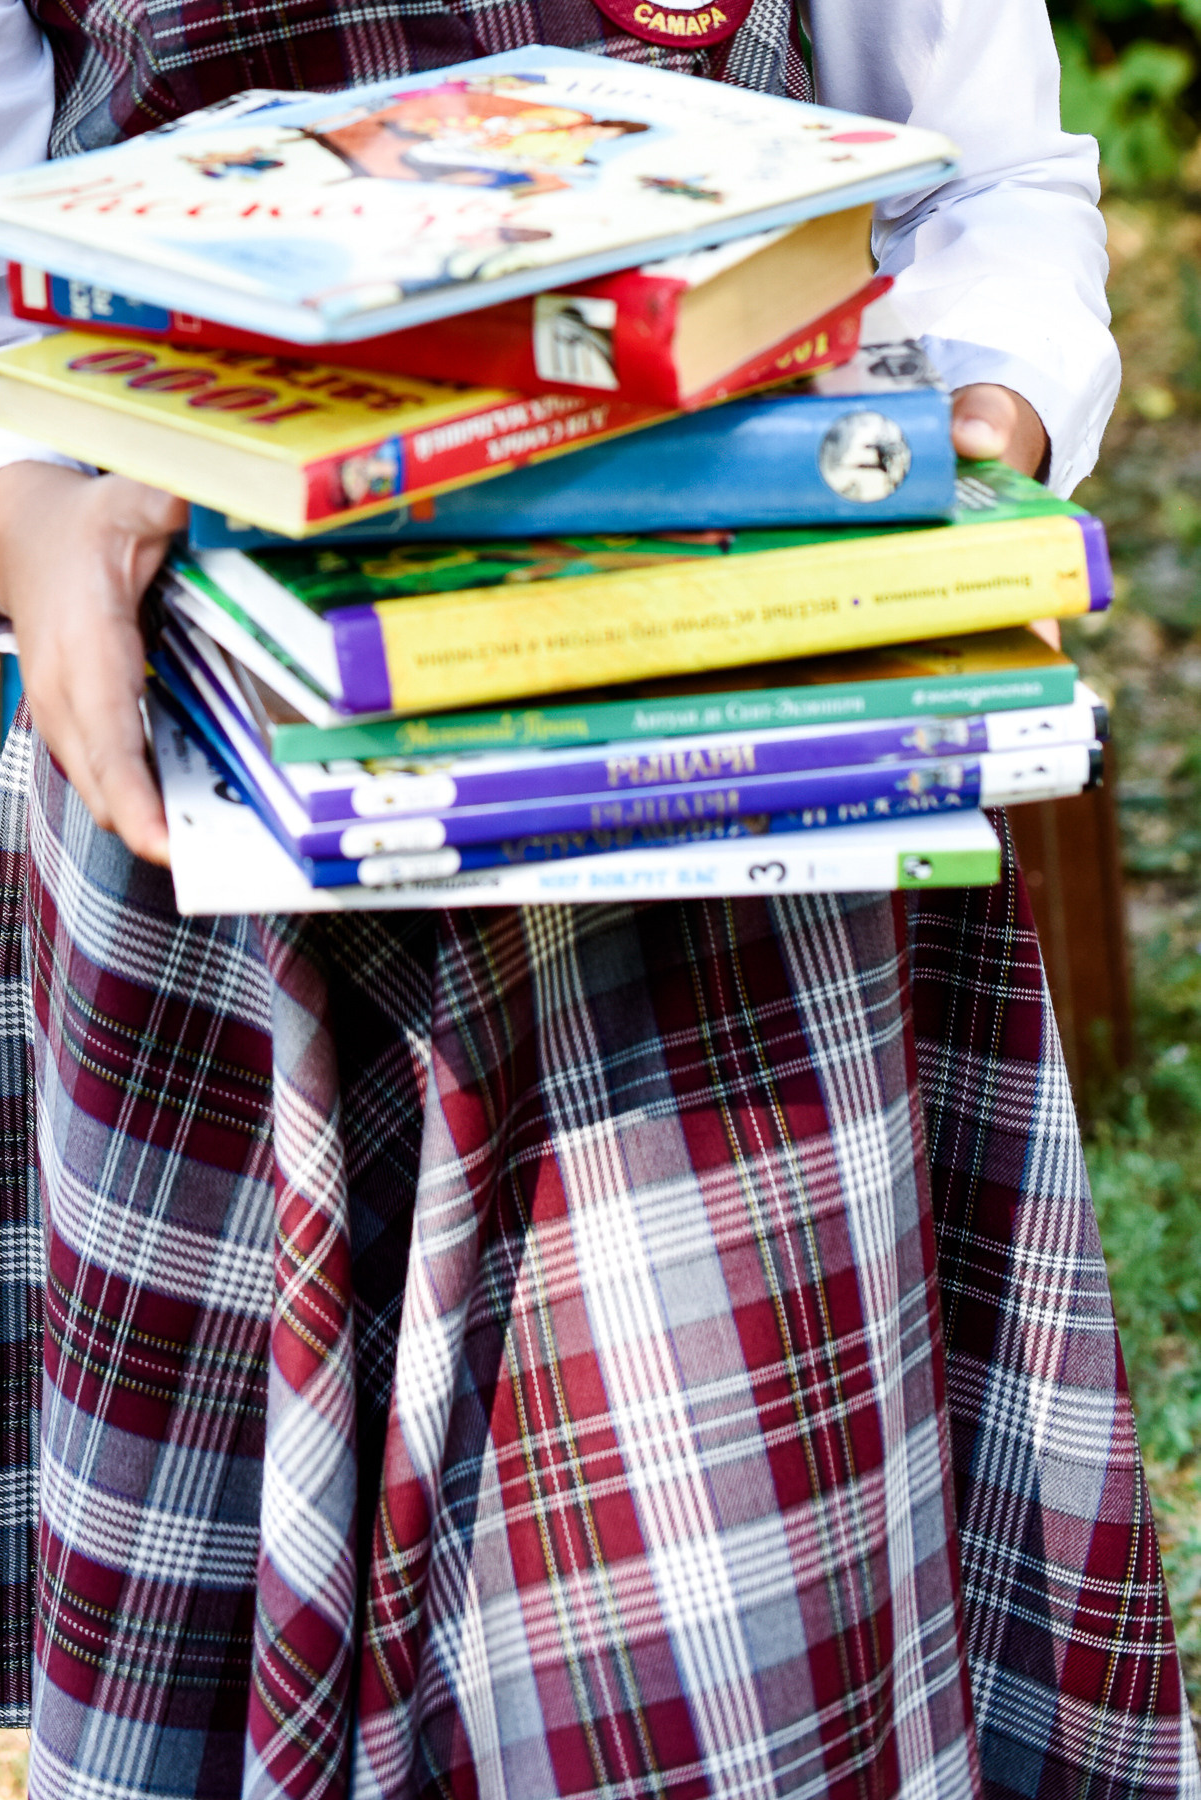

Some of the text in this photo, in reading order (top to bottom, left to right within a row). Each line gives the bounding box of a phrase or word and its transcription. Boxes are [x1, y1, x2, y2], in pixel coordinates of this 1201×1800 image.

[633, 3, 728, 36] САМАРА
[67, 347, 326, 426] 1000
[606, 744, 756, 788] РЫЦАРИ
